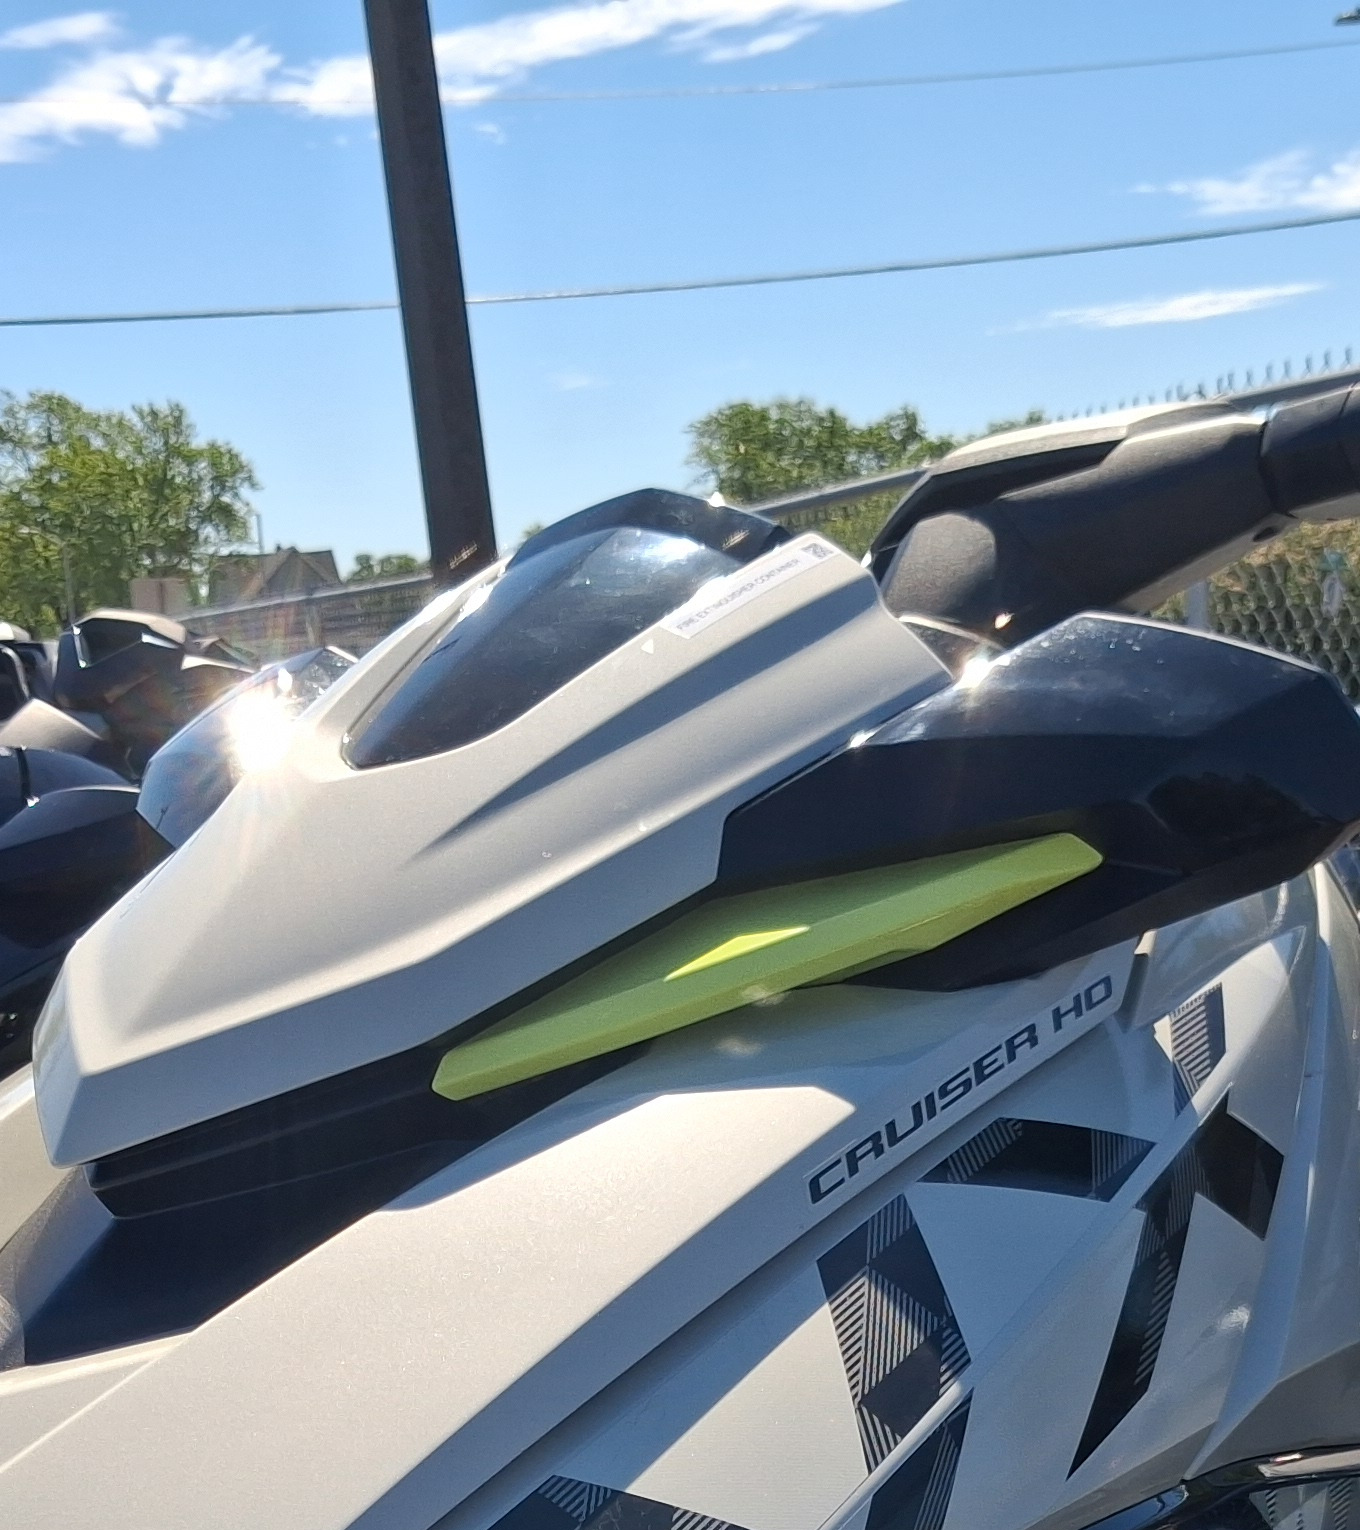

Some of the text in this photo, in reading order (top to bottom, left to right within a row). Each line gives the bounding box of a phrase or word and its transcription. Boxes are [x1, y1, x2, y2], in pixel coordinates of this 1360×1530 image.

[754, 558, 799, 584] CONTAINER
[807, 974, 1113, 1204] CRUISER HD
